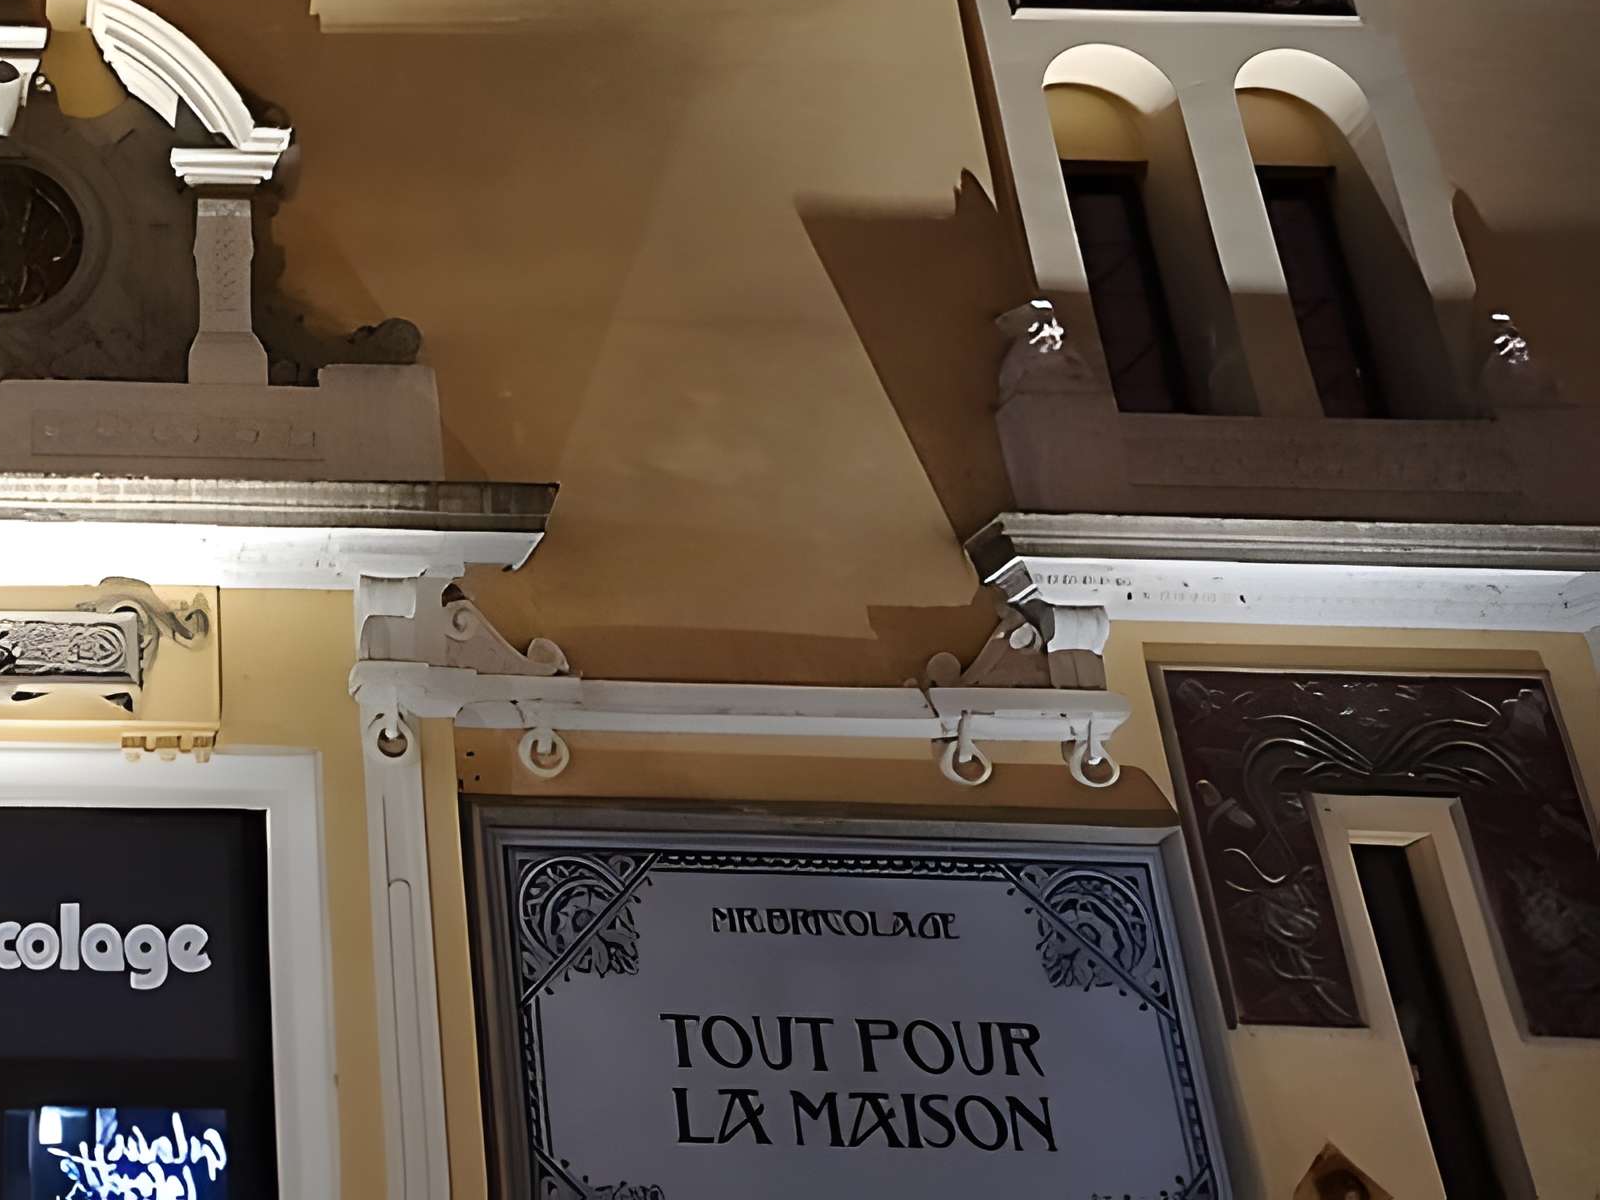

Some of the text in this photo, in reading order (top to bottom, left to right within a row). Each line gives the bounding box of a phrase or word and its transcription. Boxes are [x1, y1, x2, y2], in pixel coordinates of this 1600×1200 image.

[659, 1013, 1045, 1078] TOUT POUR
[671, 1087, 1058, 1153] LA MAISON
